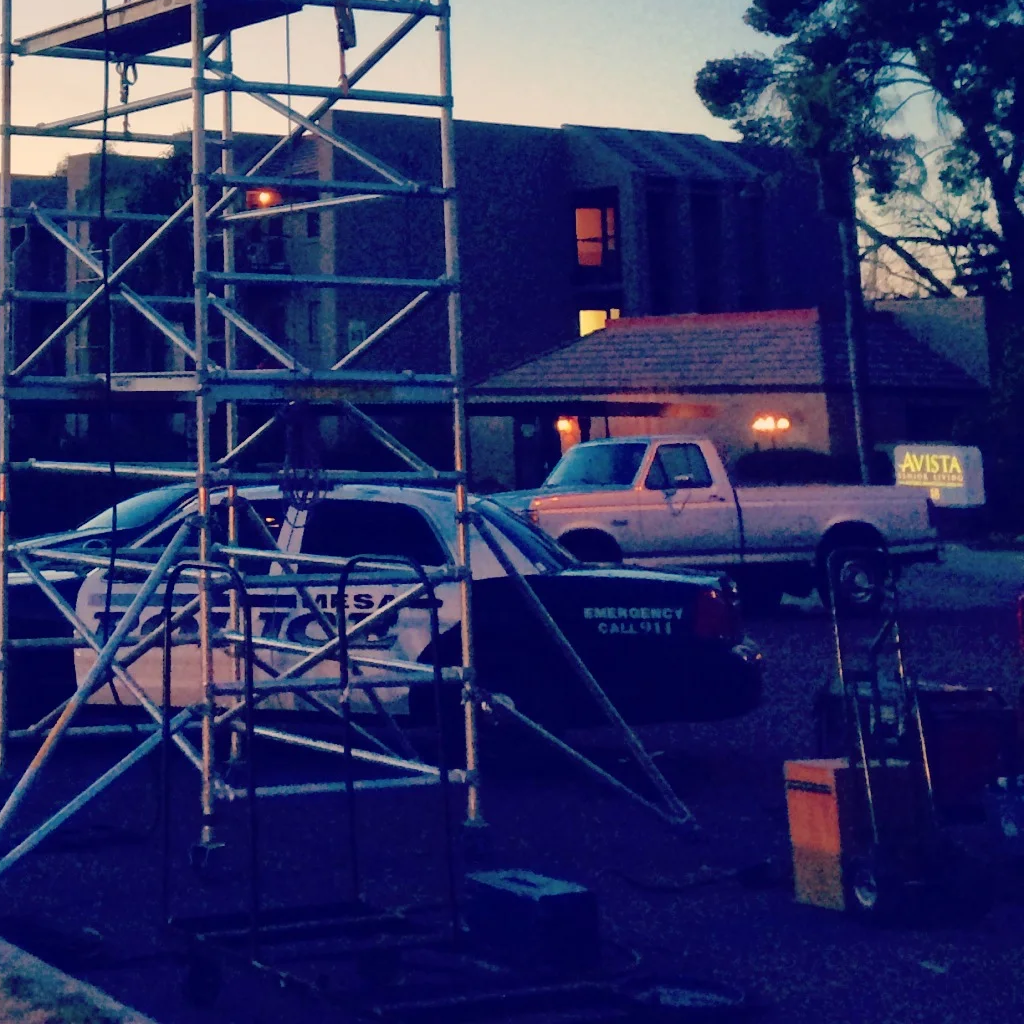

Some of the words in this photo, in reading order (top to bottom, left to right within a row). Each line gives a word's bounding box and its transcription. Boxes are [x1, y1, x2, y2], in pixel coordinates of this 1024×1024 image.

[899, 451, 962, 474] AVISTA
[301, 593, 399, 610] MESA
[583, 606, 683, 619] EMERGENCY
[597, 622, 638, 634] CALL
[639, 621, 672, 635] 911
